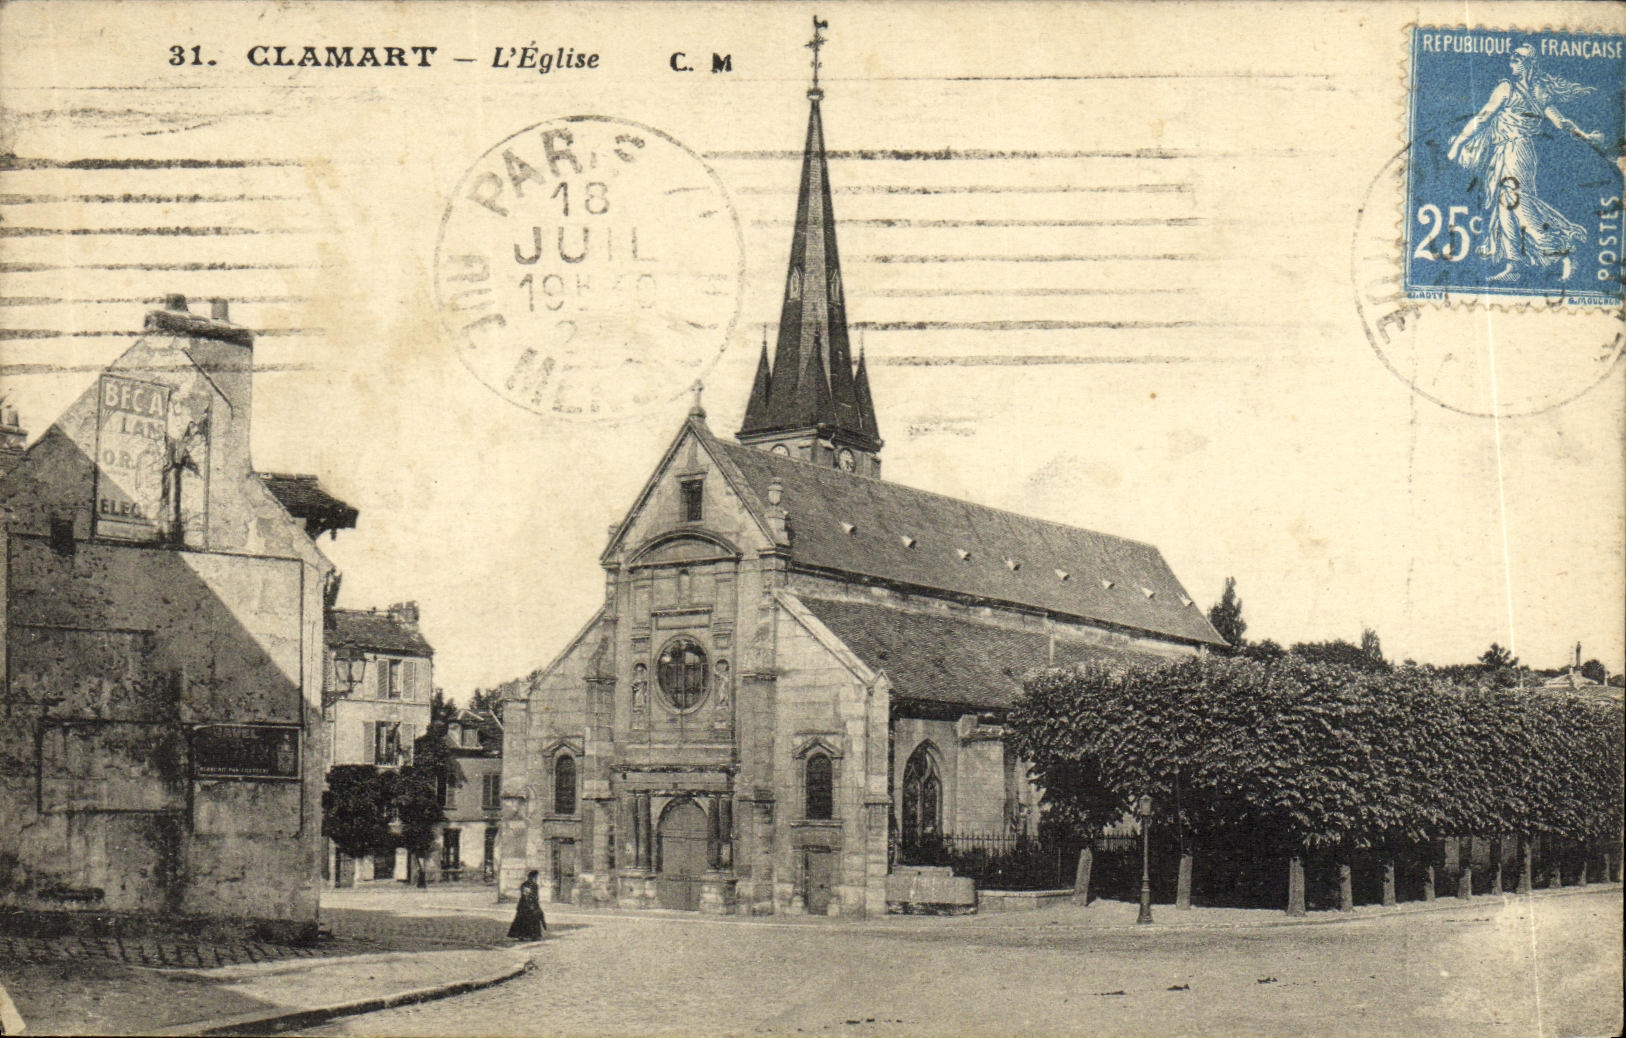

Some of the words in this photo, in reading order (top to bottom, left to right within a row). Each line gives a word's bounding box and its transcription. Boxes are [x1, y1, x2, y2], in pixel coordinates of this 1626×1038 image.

[1422, 34, 1512, 56] REPUBLIQUE
[1540, 38, 1624, 60] FRANÇAISE
[550, 181, 611, 217] 18
[513, 226, 660, 266] JUIL
[1598, 194, 1620, 281] POSTES
